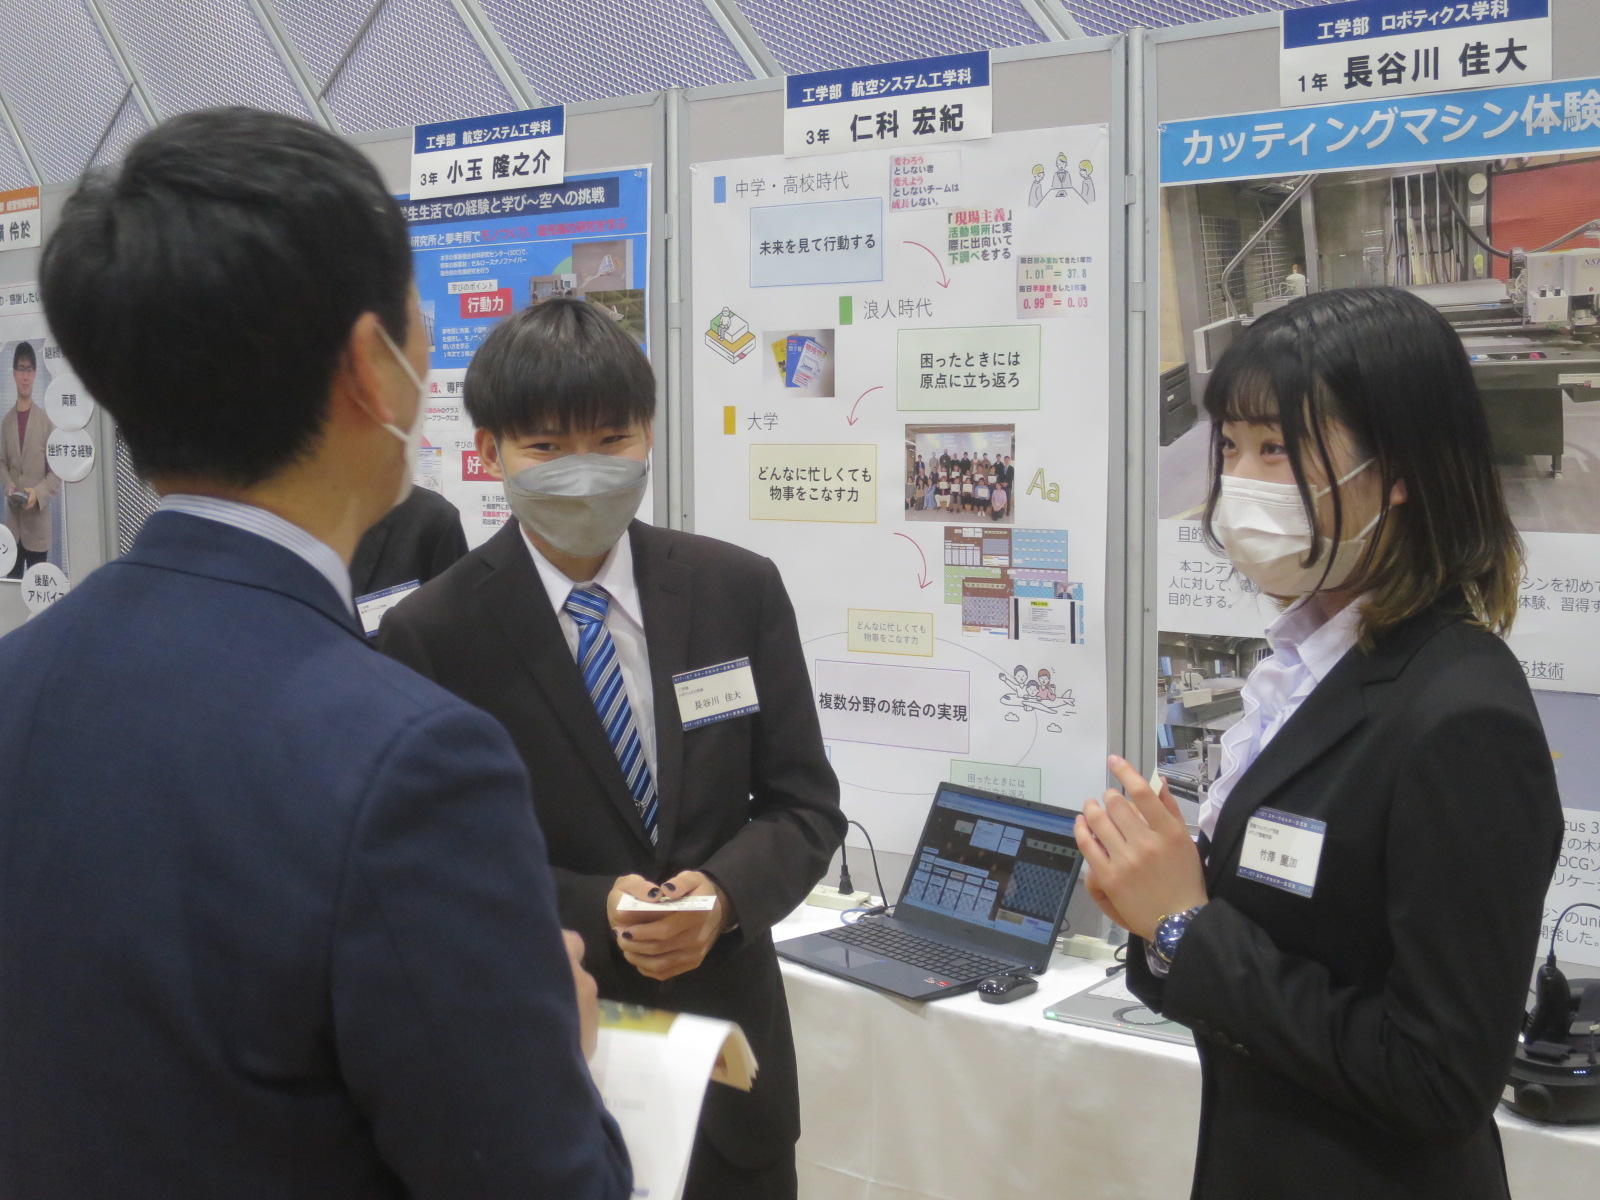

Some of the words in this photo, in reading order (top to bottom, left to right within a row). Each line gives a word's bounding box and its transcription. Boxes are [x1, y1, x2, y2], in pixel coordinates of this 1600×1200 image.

[1317, 17, 1369, 39] 工学部
[1381, 0, 1509, 31] ロボティクス学科
[1297, 73, 1328, 92] 1年
[1344, 46, 1440, 90] 長谷川
[1458, 38, 1528, 77] 佳大
[802, 84, 842, 104] 工学部
[851, 68, 972, 98] 航空システム工学科
[806, 128, 830, 145] 3年
[850, 110, 899, 142] 仁科
[912, 103, 964, 134] 宏紀
[1182, 89, 1600, 167] カッティングマシン体験
[425, 133, 456, 149] 工学部
[462, 120, 551, 145] 航空システム工学科
[420, 172, 438, 186] 3年
[447, 158, 483, 184] 小玉
[492, 149, 551, 179] 隆之介
[735, 171, 850, 198] 中学・高校時代
[893, 184, 960, 198] としないチームは
[760, 234, 877, 256] 未来を見て行動する
[948, 236, 1012, 253] 際に出向いて
[948, 248, 1011, 265] 下調べをする
[468, 296, 504, 313] 行動力
[863, 298, 933, 320] 浪人時代
[919, 350, 1021, 369] 困ったときには
[61, 393, 77, 407] 両親
[747, 411, 779, 431] 大学
[48, 444, 93, 458] 挫折する経験
[758, 466, 873, 483] どんなに忙しくても
[769, 485, 860, 503] 物事をこなす力
[1180, 560, 1233, 574] 本コンテ
[34, 574, 58, 587] 後輩へ
[1168, 592, 1233, 609] 目的とする。
[855, 621, 927, 636] どんなに忙しくても
[695, 696, 720, 710] 長谷川
[818, 692, 968, 722] 複数分野の統合の実現
[1553, 871, 1600, 891] リケー
